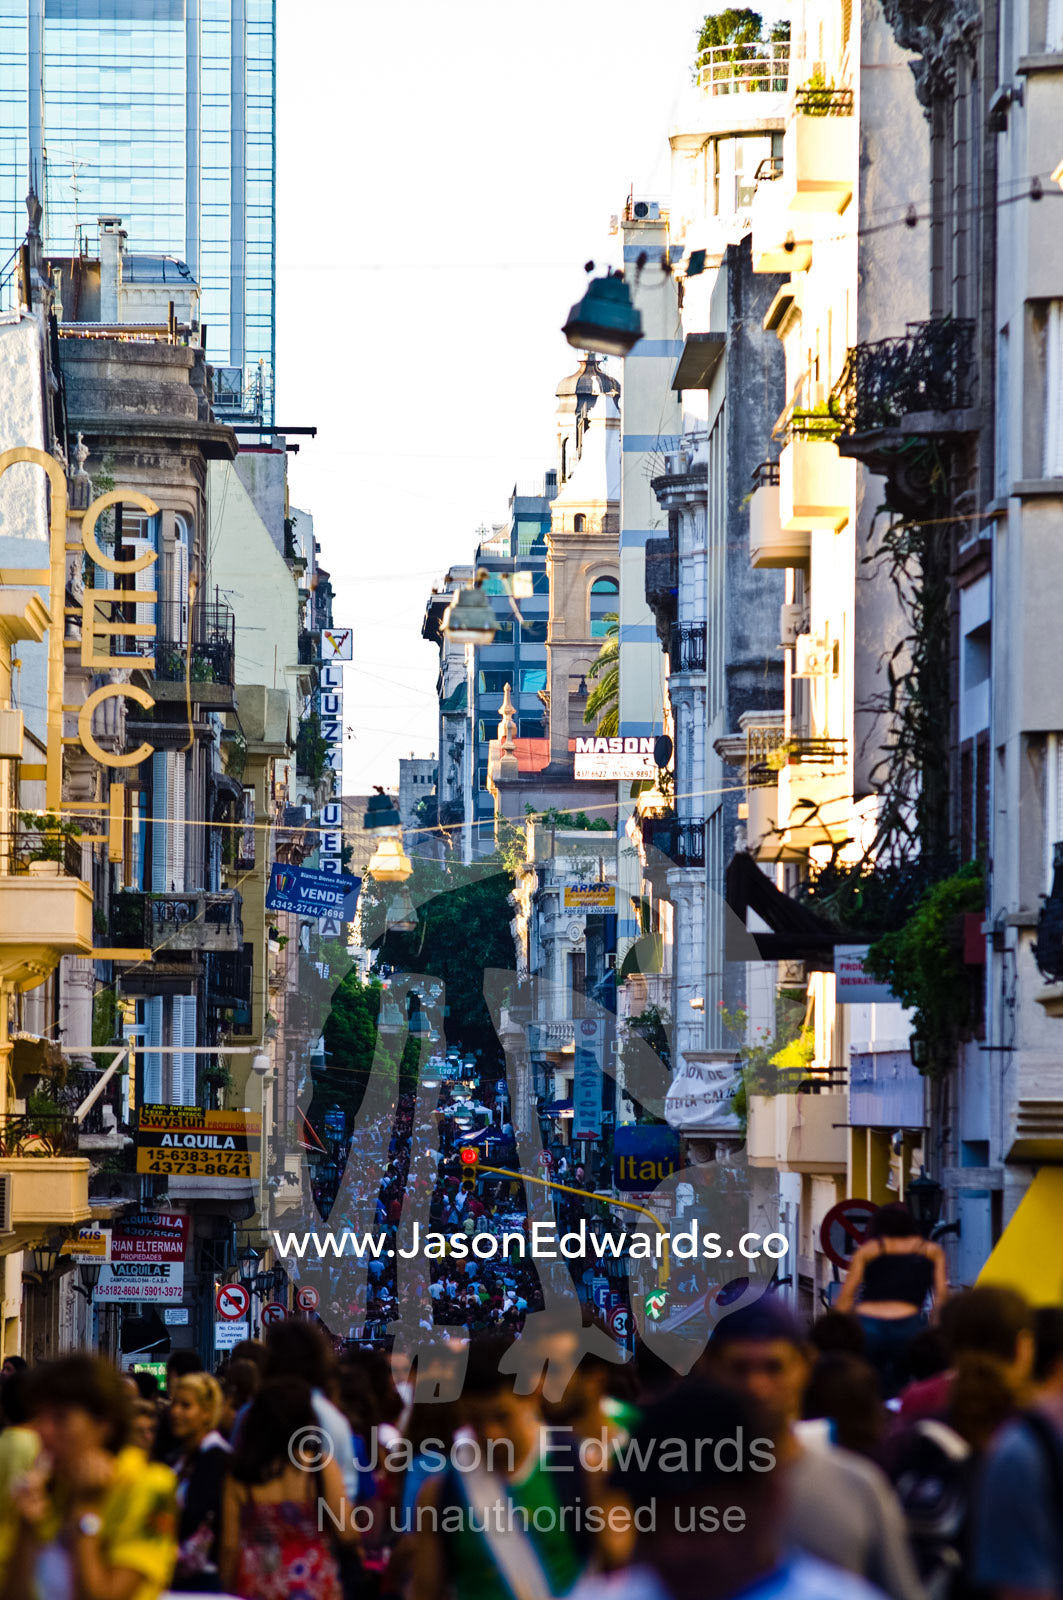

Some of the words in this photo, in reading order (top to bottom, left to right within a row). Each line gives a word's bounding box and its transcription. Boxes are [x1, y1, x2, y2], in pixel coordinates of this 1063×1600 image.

[576, 737, 655, 753] MASON
[300, 887, 345, 904] VENDE
[270, 899, 344, 920] 4342-2744/3696
[141, 1112, 205, 1129] Swystun
[161, 1134, 236, 1150] ALQUILA
[147, 1149, 252, 1164] 15-6383-1723
[149, 1161, 251, 1177] 4373-8641
[619, 1155, 674, 1180] Itaú
[136, 1241, 183, 1253] ELTERMAN
[95, 1285, 140, 1296] 15-5182-8604
